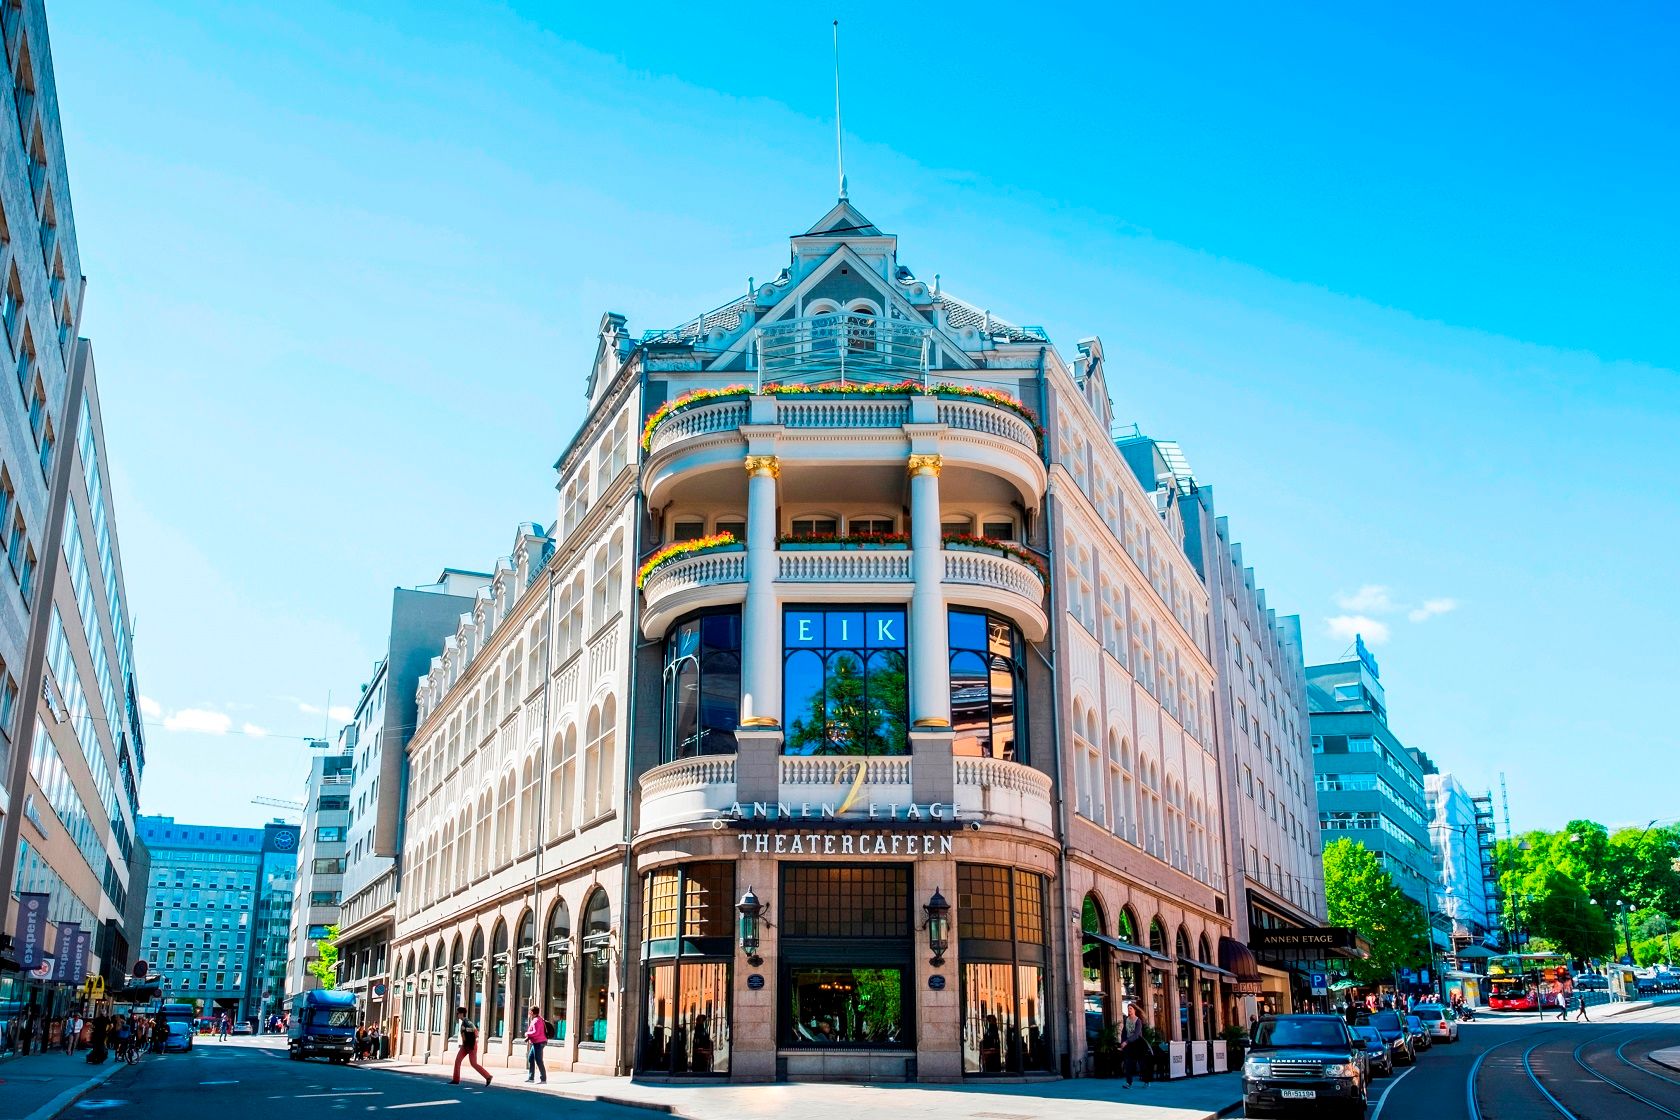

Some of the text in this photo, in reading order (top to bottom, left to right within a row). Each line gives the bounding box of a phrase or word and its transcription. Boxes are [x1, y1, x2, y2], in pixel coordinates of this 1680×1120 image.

[799, 619, 896, 641] EIK
[730, 802, 962, 817] ANNEN ETAGE
[738, 833, 953, 855] THEATERCAFEEN
[24, 911, 38, 964] expert
[1264, 935, 1333, 944] ANNEN ETAGE
[59, 937, 71, 977] expert
[73, 944, 83, 981] expert
[1313, 975, 1322, 986] P
